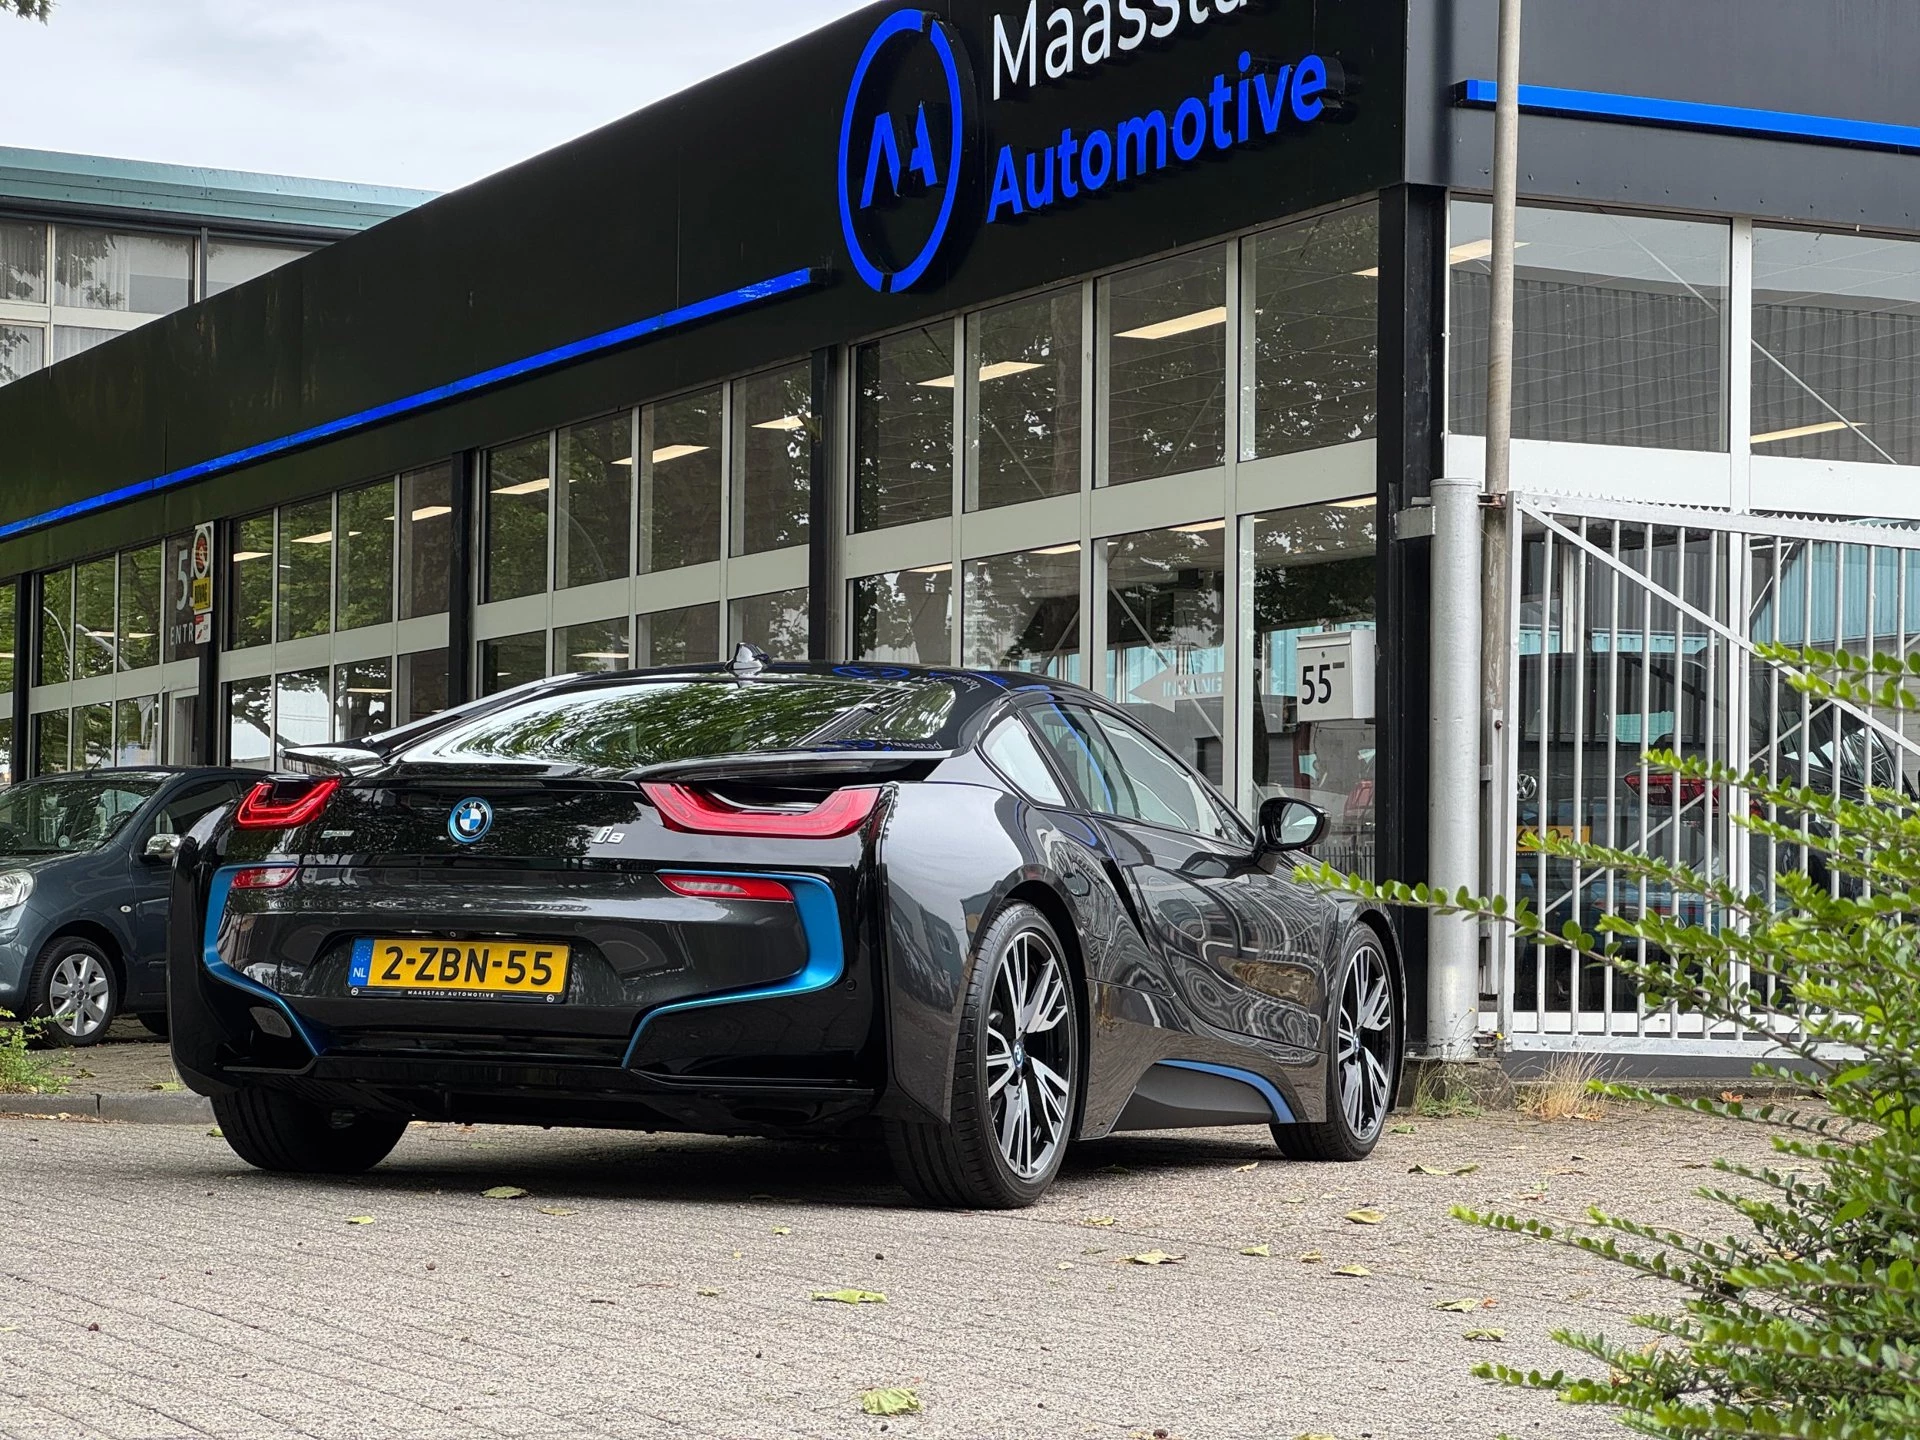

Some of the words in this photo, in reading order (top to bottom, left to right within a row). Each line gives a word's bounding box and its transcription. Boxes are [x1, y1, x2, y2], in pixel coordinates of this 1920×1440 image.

[986, 51, 1328, 224] Automotive
[170, 623, 194, 646] ENTR
[1301, 665, 1332, 705] 55
[591, 826, 625, 844] i8
[352, 967, 367, 978] NL
[381, 946, 553, 985] 2-ZBN-55
